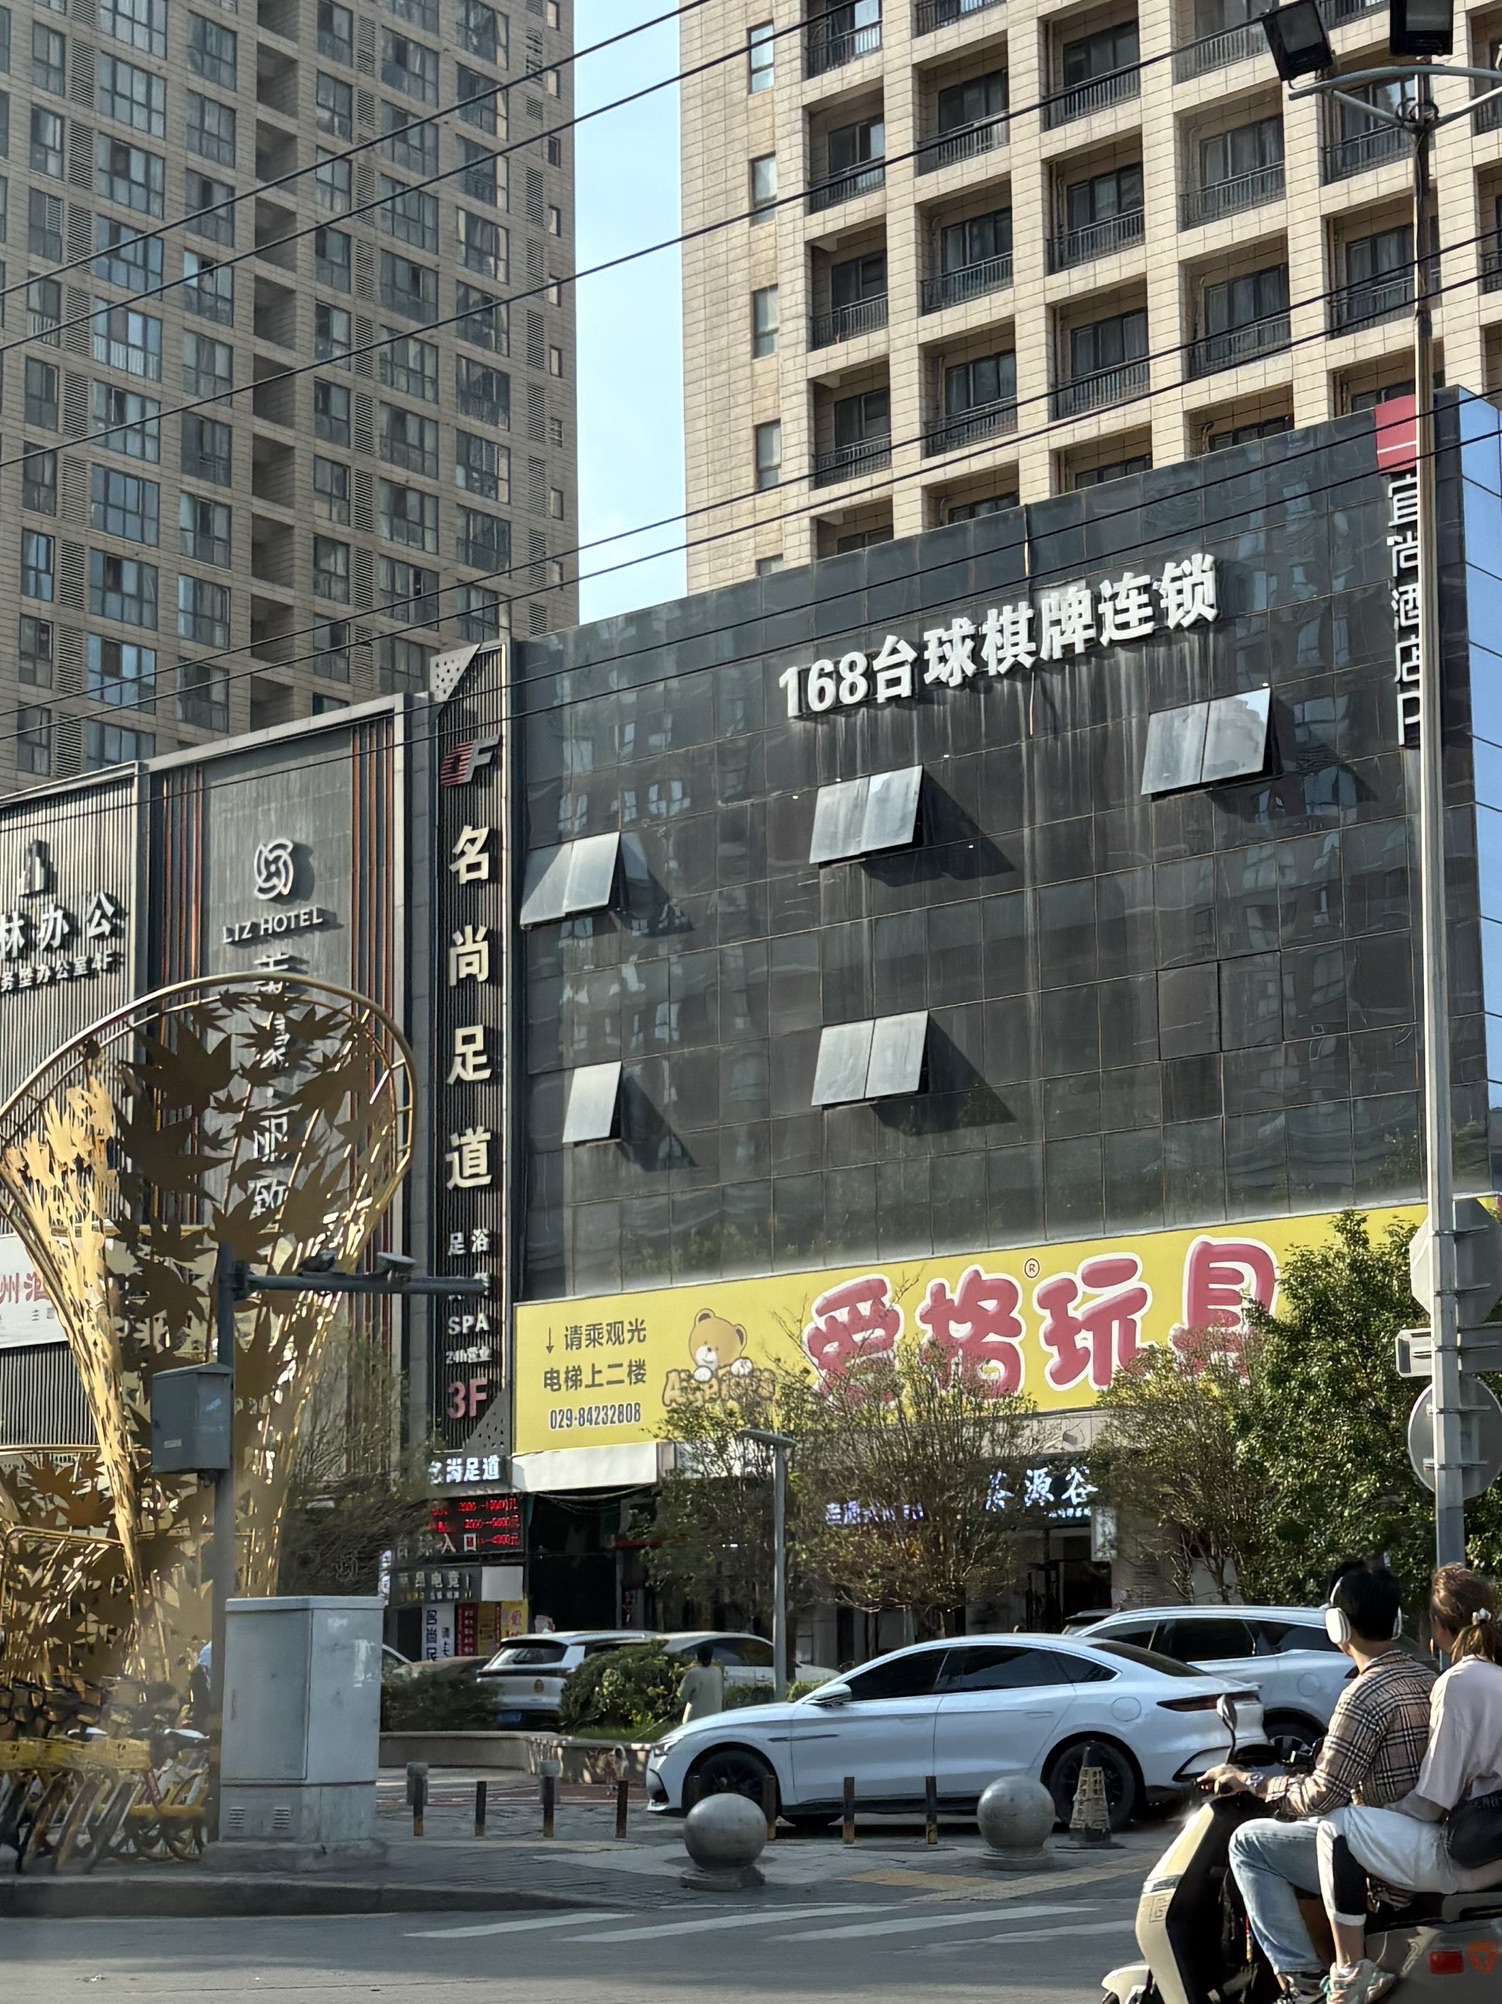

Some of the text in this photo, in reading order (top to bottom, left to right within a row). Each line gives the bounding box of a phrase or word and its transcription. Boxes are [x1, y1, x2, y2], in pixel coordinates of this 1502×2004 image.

[779, 552, 1219, 719] 168台球棋牌连锁
[222, 907, 323, 944] LIZ HOTEL
[445, 825, 493, 1190] 名尚足道
[447, 1228, 490, 1256] 足浴
[448, 1313, 490, 1336] SPA
[564, 1317, 647, 1351] 请乘观光
[543, 1358, 647, 1392] 电梯上二楼
[446, 1377, 488, 1419] 3F
[549, 1402, 642, 1430] 029-84232808
